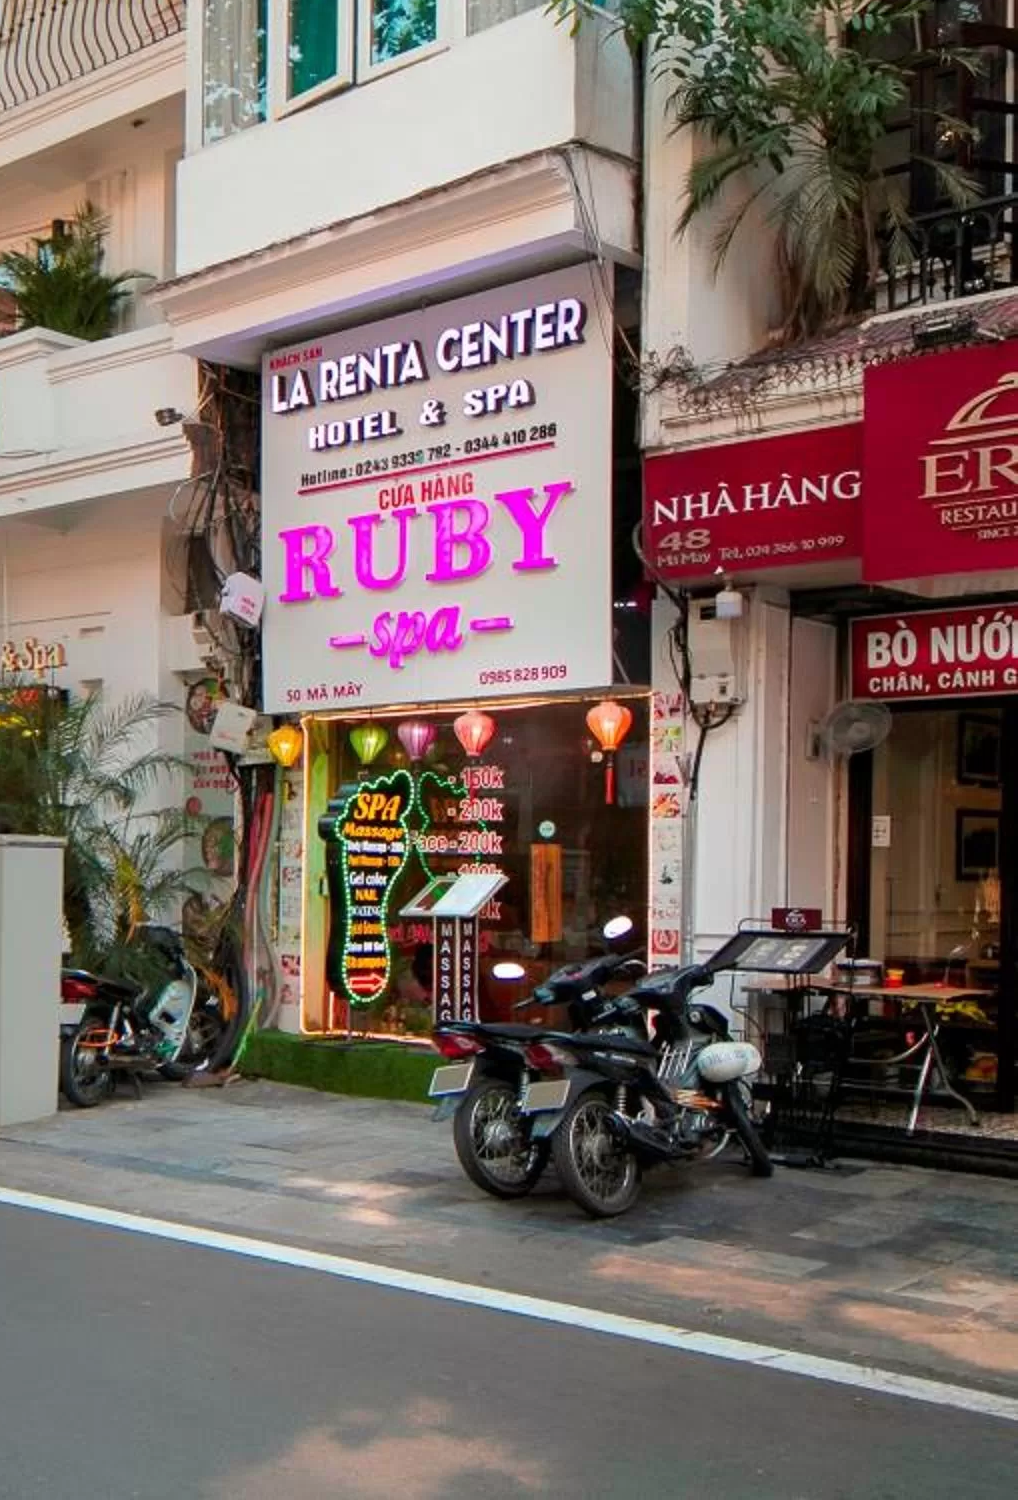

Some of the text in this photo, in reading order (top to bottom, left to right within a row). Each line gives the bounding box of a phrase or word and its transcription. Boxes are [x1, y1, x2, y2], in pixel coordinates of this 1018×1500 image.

[272, 298, 584, 414] LA RENTA CENTER
[308, 379, 534, 450] HOTEL & SPA
[356, 458, 390, 477] 0243
[464, 434, 499, 455] 0344
[503, 427, 527, 446] 410
[652, 471, 863, 527] NHÀ HÀNG
[277, 481, 574, 604] RUBY
[657, 528, 711, 551] 48
[20, 638, 67, 679] Spa
[365, 604, 465, 669] spa
[867, 619, 918, 669] BÒ
[353, 792, 402, 821] SPA
[459, 798, 504, 821] 200k
[343, 821, 405, 842] Massage
[457, 830, 503, 854] 200k
[349, 871, 388, 887] Gel color
